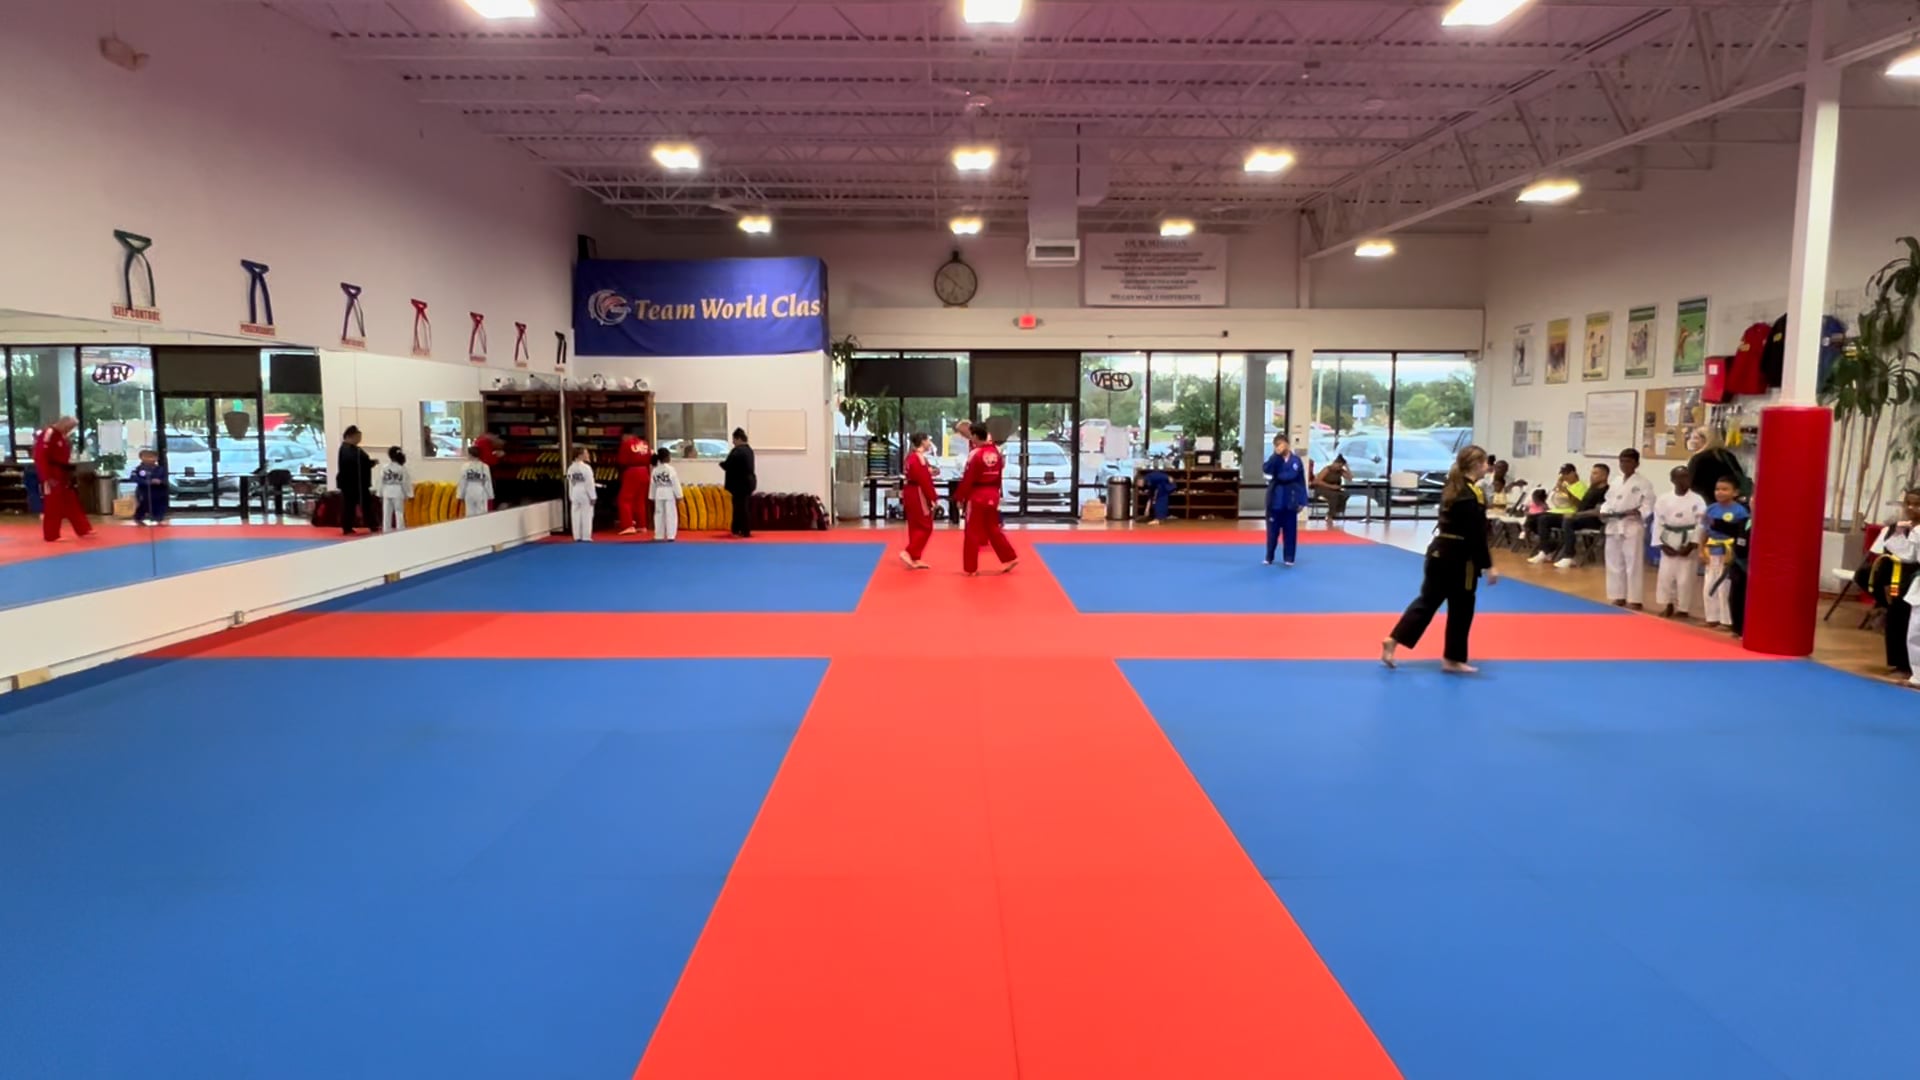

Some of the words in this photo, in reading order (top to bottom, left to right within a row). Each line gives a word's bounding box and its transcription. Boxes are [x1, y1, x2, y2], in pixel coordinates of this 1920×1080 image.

[635, 299, 695, 320] Team
[701, 294, 767, 320] World
[771, 293, 824, 318] Clas
